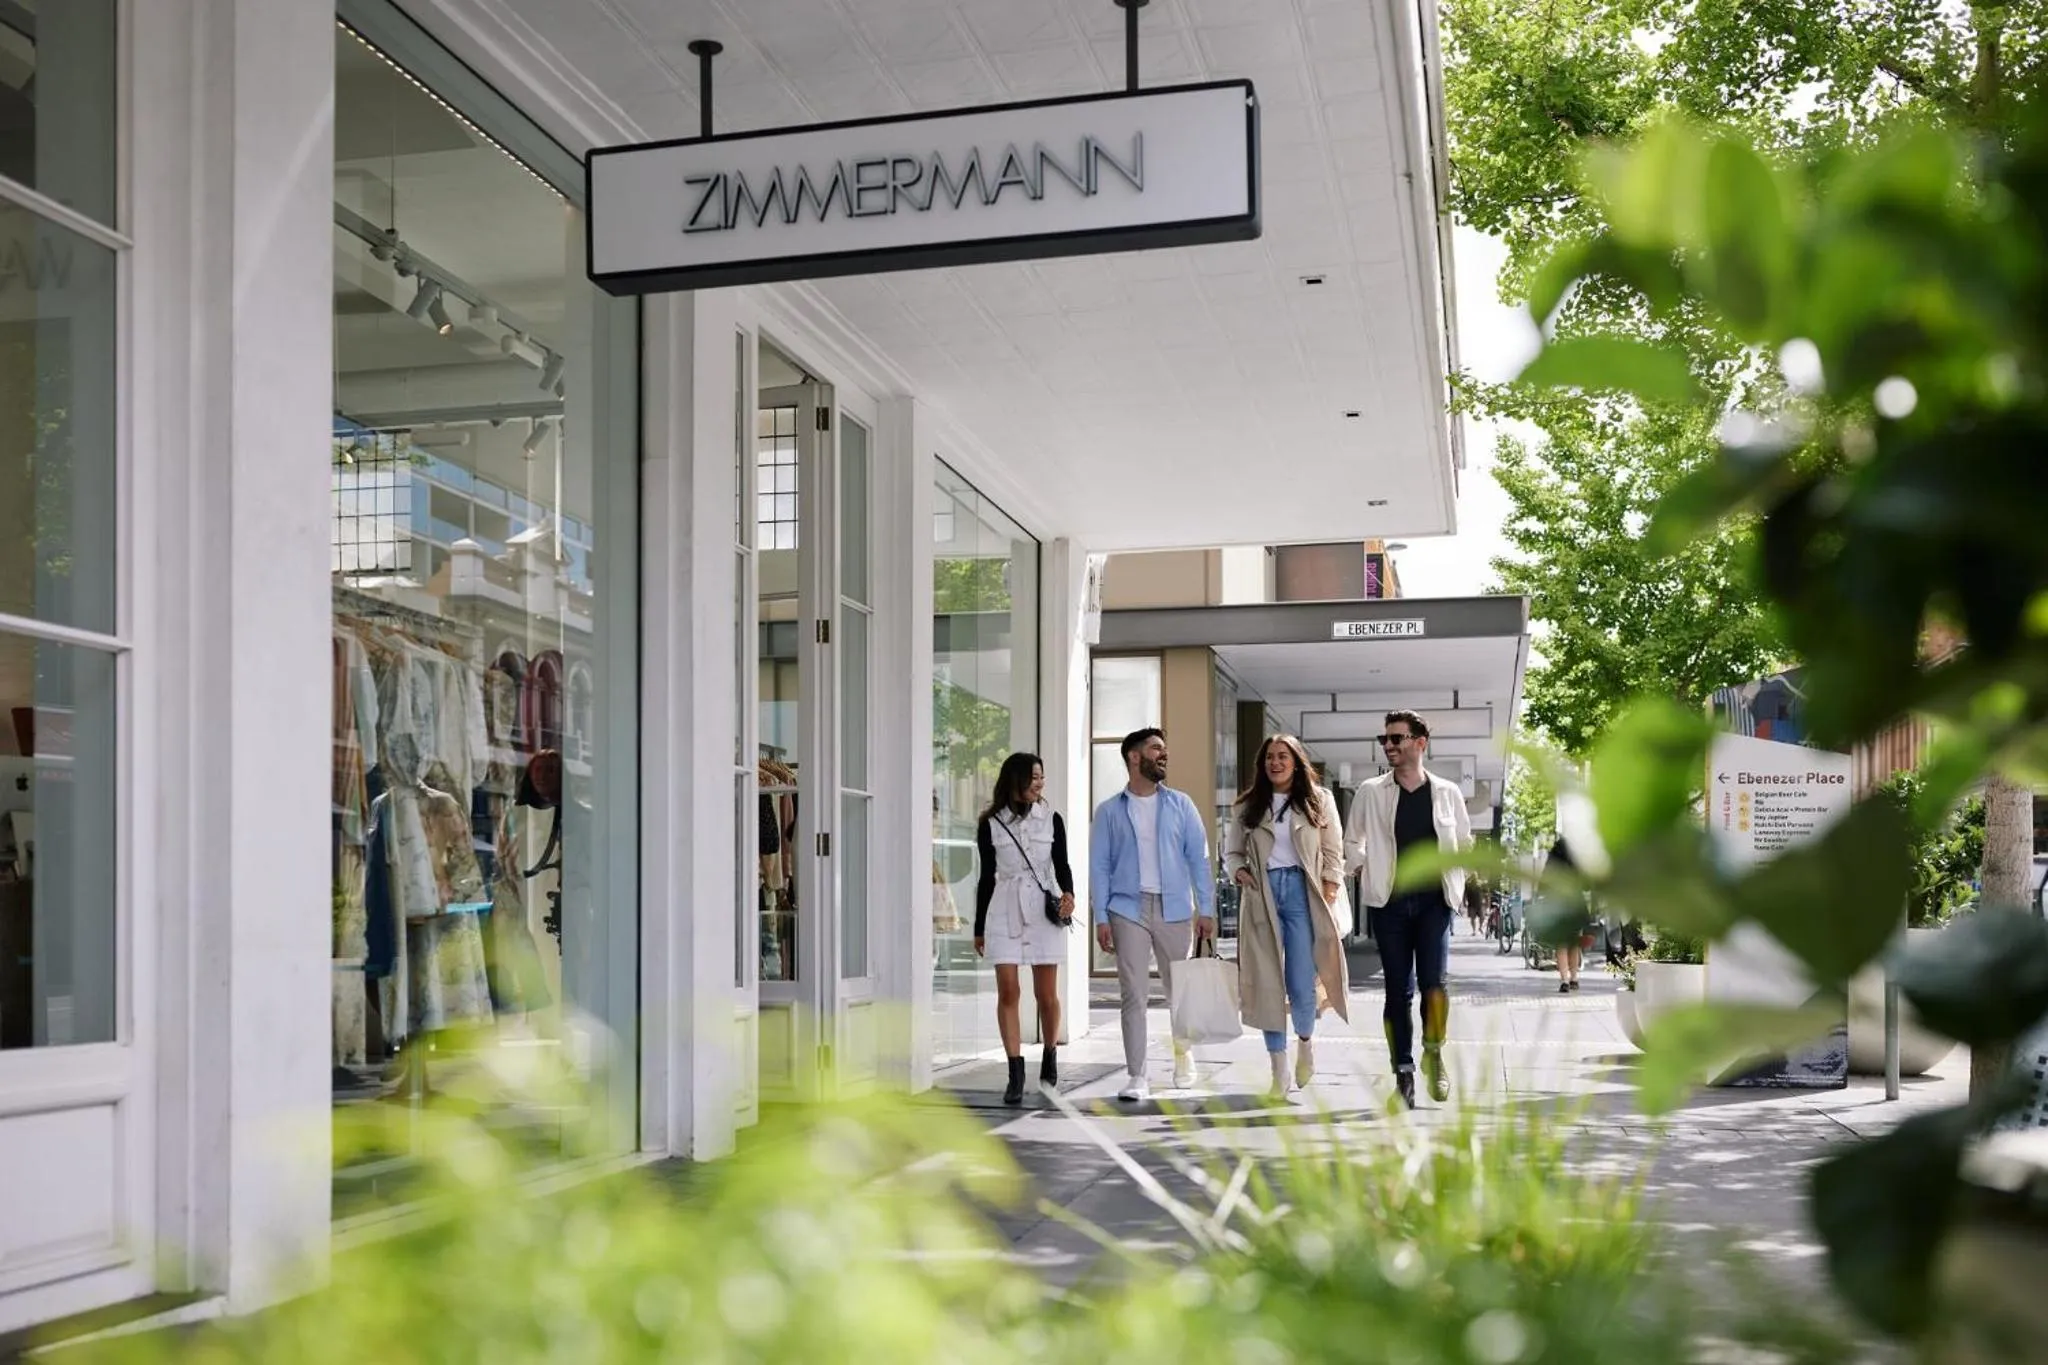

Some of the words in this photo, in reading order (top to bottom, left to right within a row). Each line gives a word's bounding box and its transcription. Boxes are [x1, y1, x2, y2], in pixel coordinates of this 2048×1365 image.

[683, 130, 1144, 235] ZIMMERMANN
[1348, 622, 1402, 635] EBENEZER
[1406, 622, 1420, 634] PL
[1737, 772, 1803, 784] Ebenezer
[1806, 772, 1844, 784] Place
